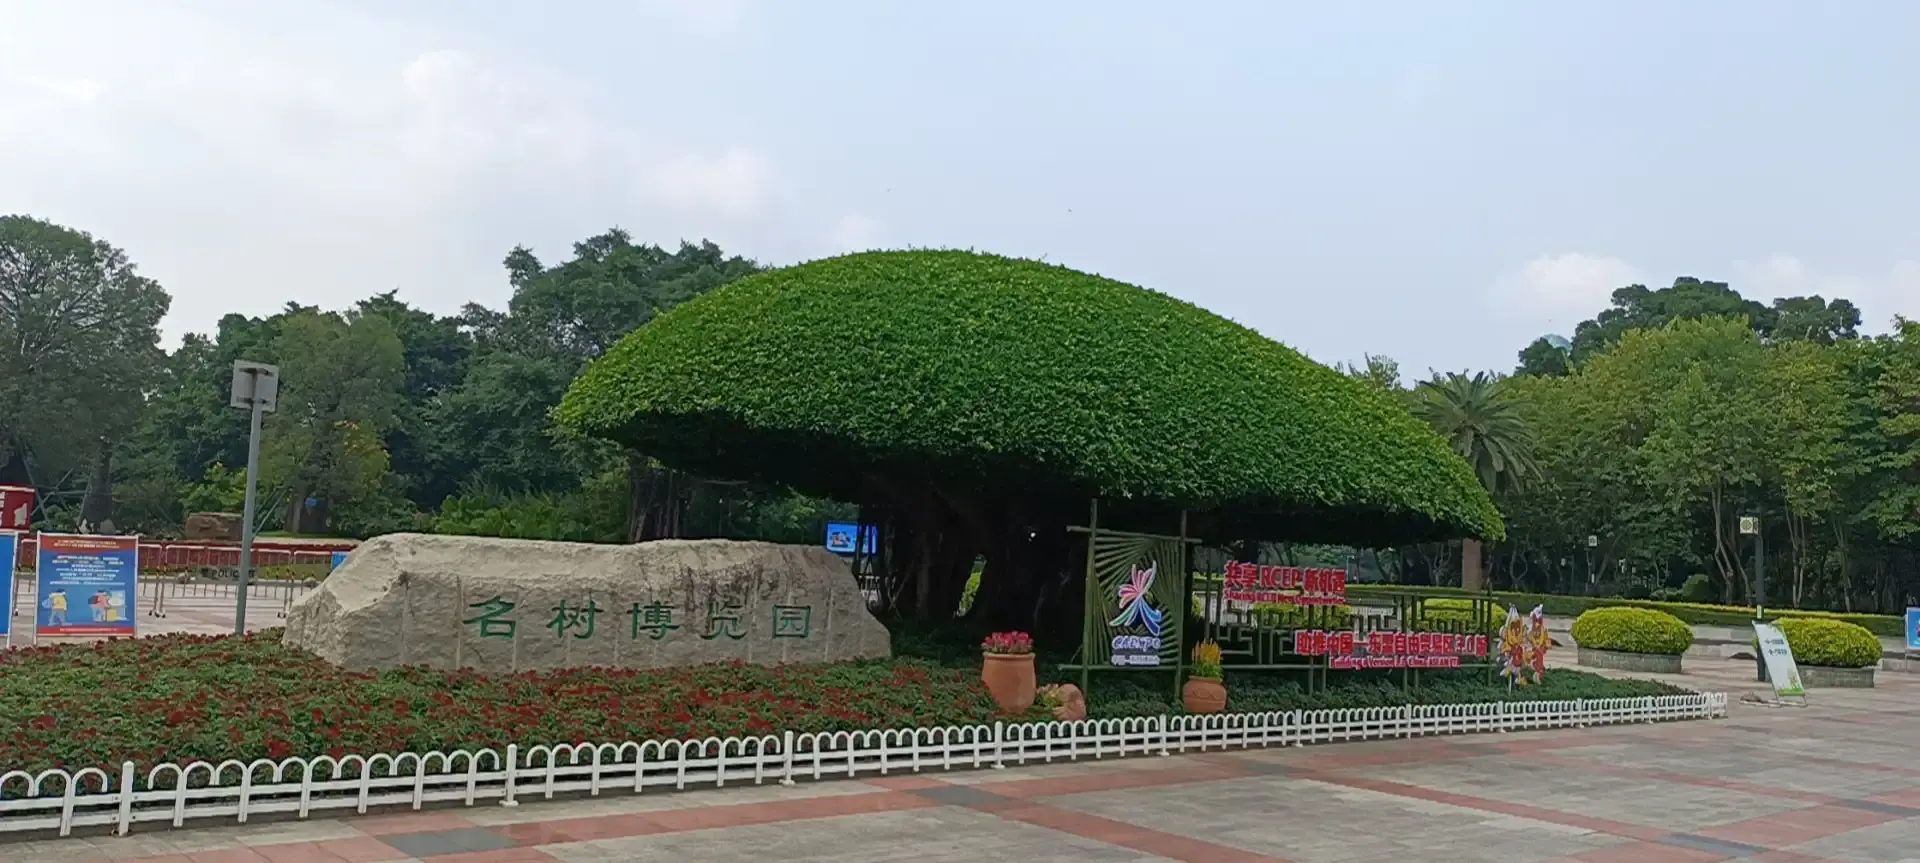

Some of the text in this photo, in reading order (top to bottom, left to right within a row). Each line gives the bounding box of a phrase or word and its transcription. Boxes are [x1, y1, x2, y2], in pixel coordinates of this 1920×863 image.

[1224, 560, 1345, 594] 共享 RCEP 新机遇
[462, 595, 812, 641] 名树博览园
